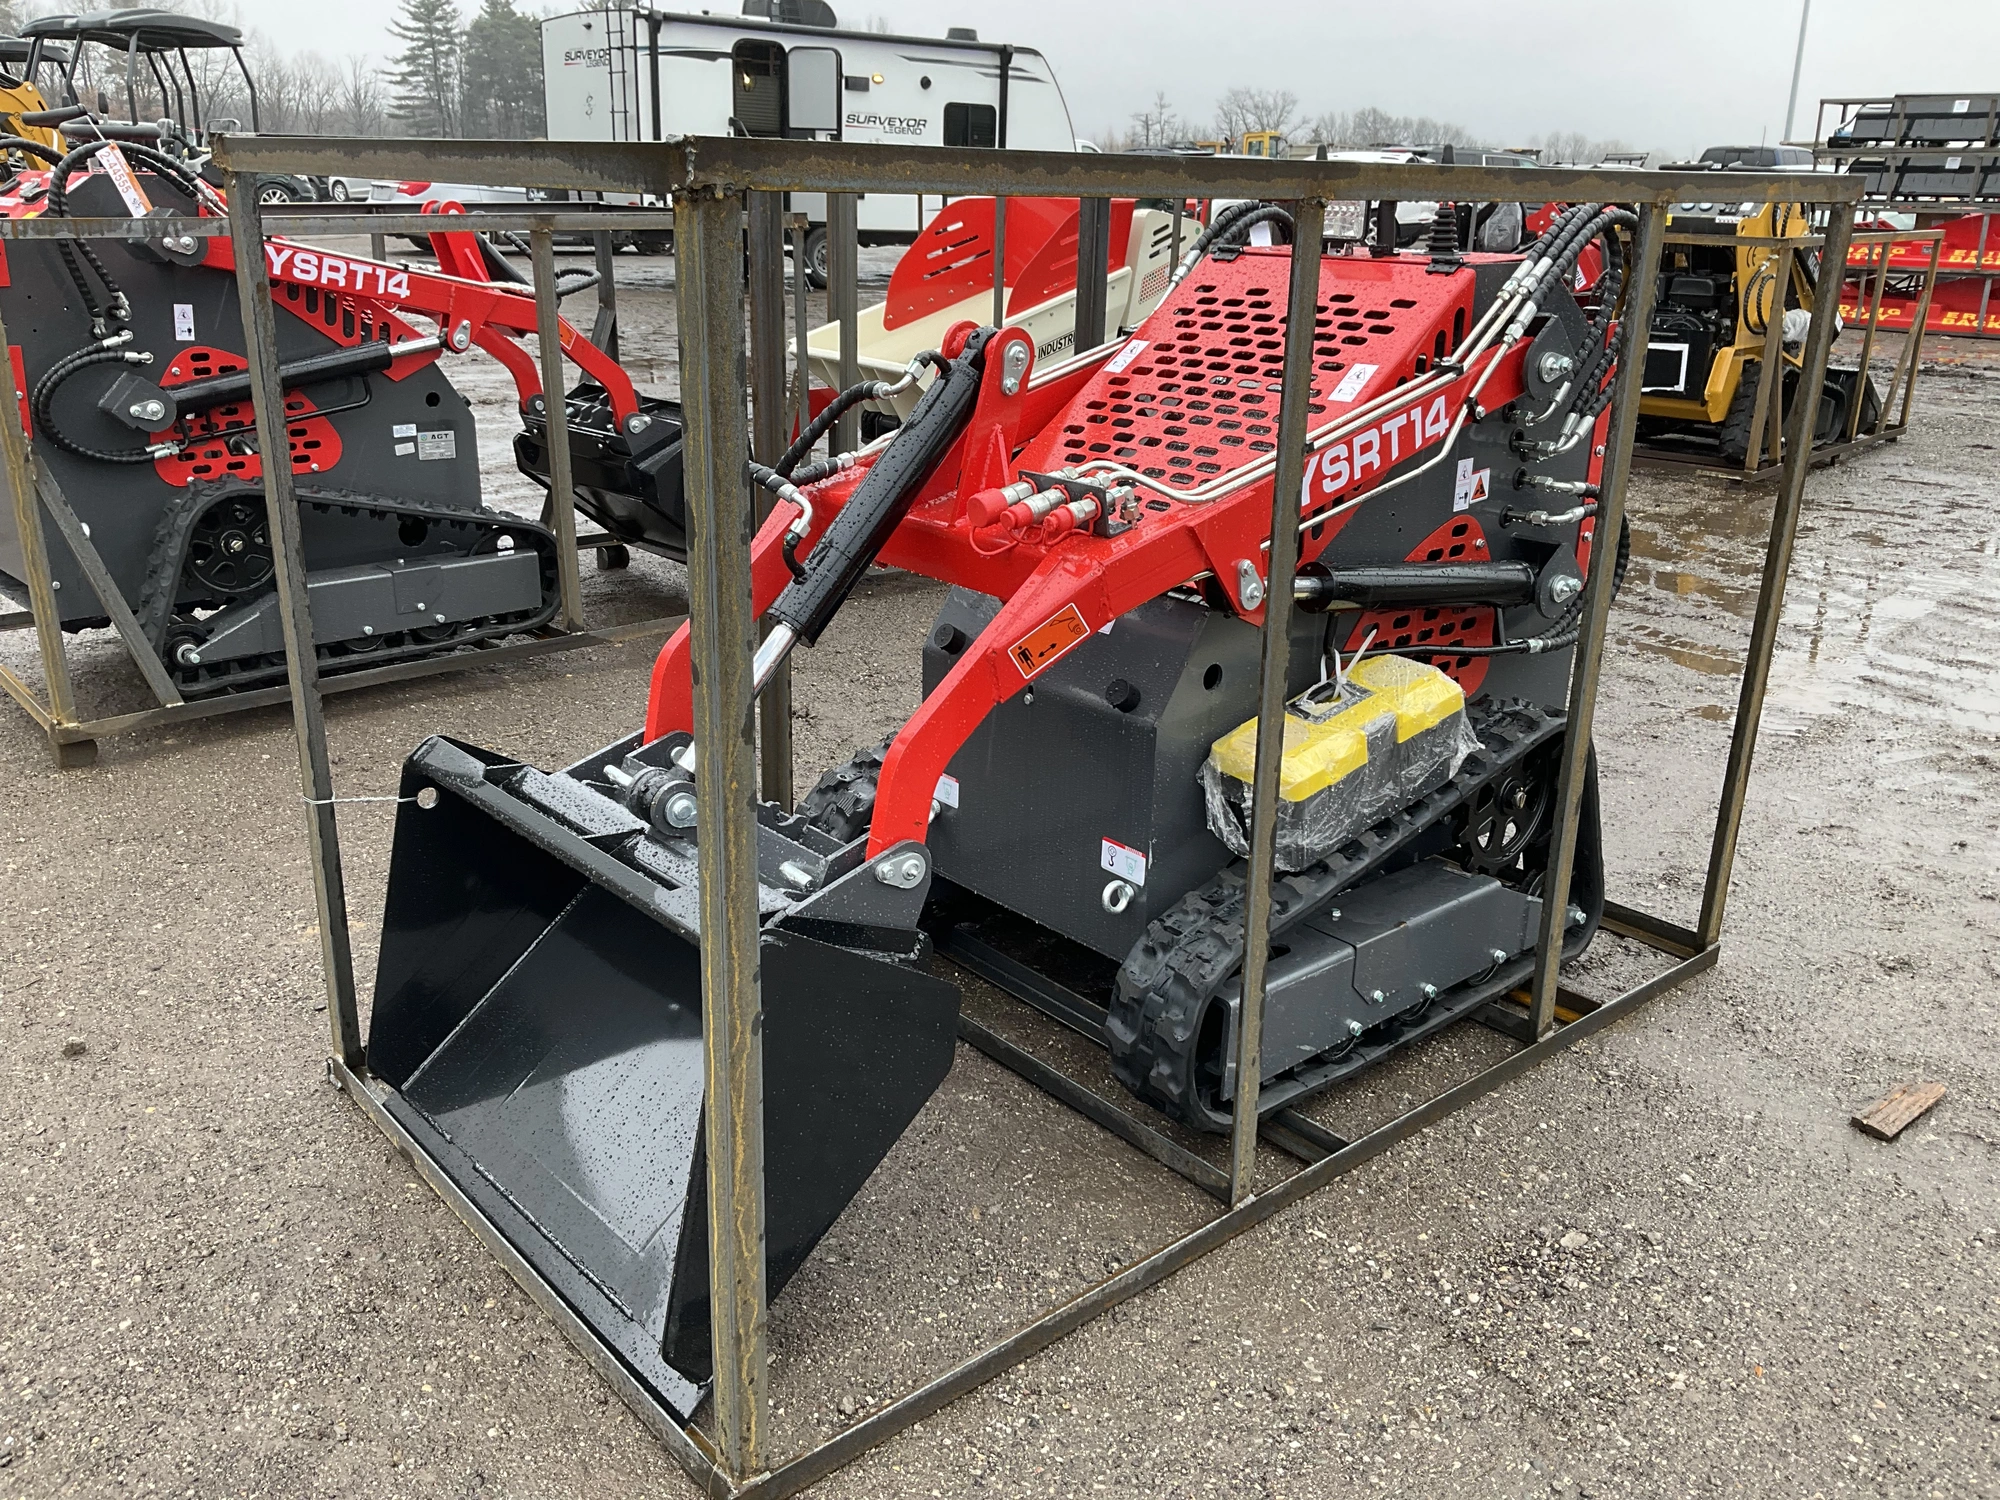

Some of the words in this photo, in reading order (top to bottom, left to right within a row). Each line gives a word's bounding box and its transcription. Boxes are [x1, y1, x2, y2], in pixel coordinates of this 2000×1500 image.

[564, 49, 610, 61] SURVEYOR
[586, 59, 609, 67] LEGEND
[846, 114, 927, 128] SURVEYOR
[883, 126, 922, 135] LEGEND
[100, 151, 132, 194] 2-44555
[264, 245, 410, 298] YSRT14
[1302, 395, 1449, 506] YSRT14
